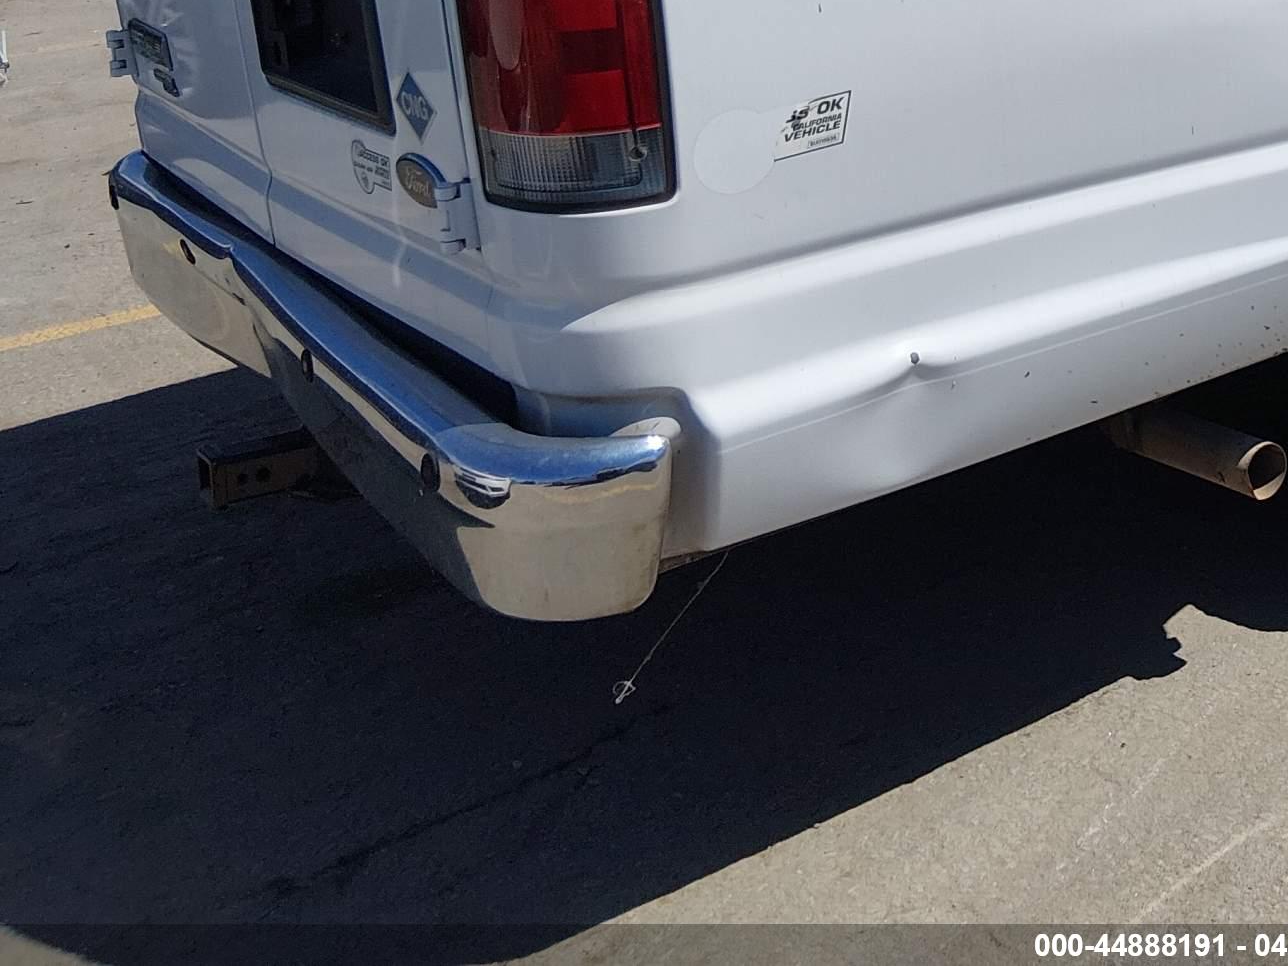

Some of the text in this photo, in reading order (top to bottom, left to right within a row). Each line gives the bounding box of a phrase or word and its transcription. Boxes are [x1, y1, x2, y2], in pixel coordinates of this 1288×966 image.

[402, 91, 429, 121] CNG
[817, 96, 845, 115] OK
[784, 120, 841, 142] VEHICLE
[791, 113, 842, 131] CALIFORNIA
[405, 165, 429, 196] Ford
